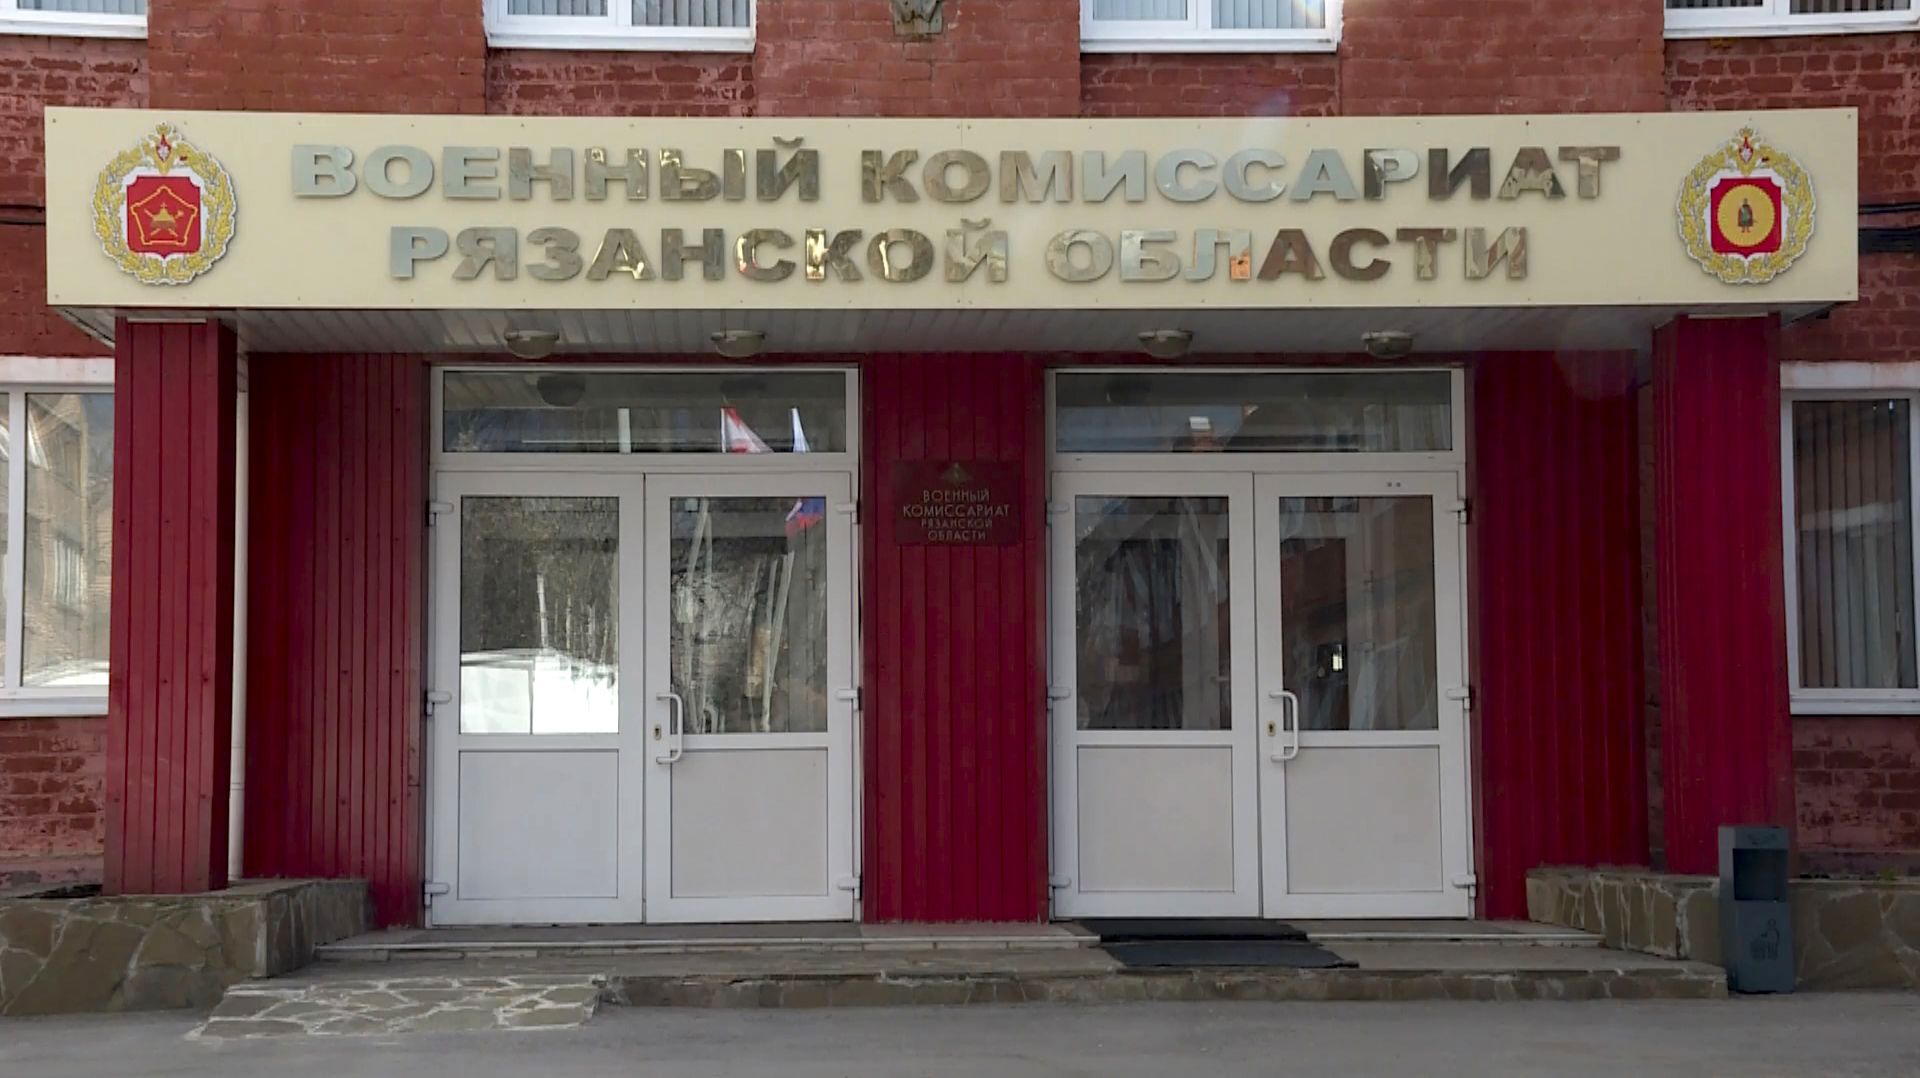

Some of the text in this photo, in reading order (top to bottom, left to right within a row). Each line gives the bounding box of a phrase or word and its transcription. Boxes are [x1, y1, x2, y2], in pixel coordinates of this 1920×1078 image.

[292, 136, 1621, 204] ВОЕННЫЙ КОМИССАРИАТ
[389, 217, 1528, 282] РЯЗАНСКОЙ ОБЛАСТИ
[923, 488, 990, 502] ВОЕННЫЙ
[903, 504, 1009, 517] КОМИССАРИАТ
[921, 517, 993, 529] РЯЗАНСКОЙ
[928, 530, 986, 541] ОБЛАСТИ
